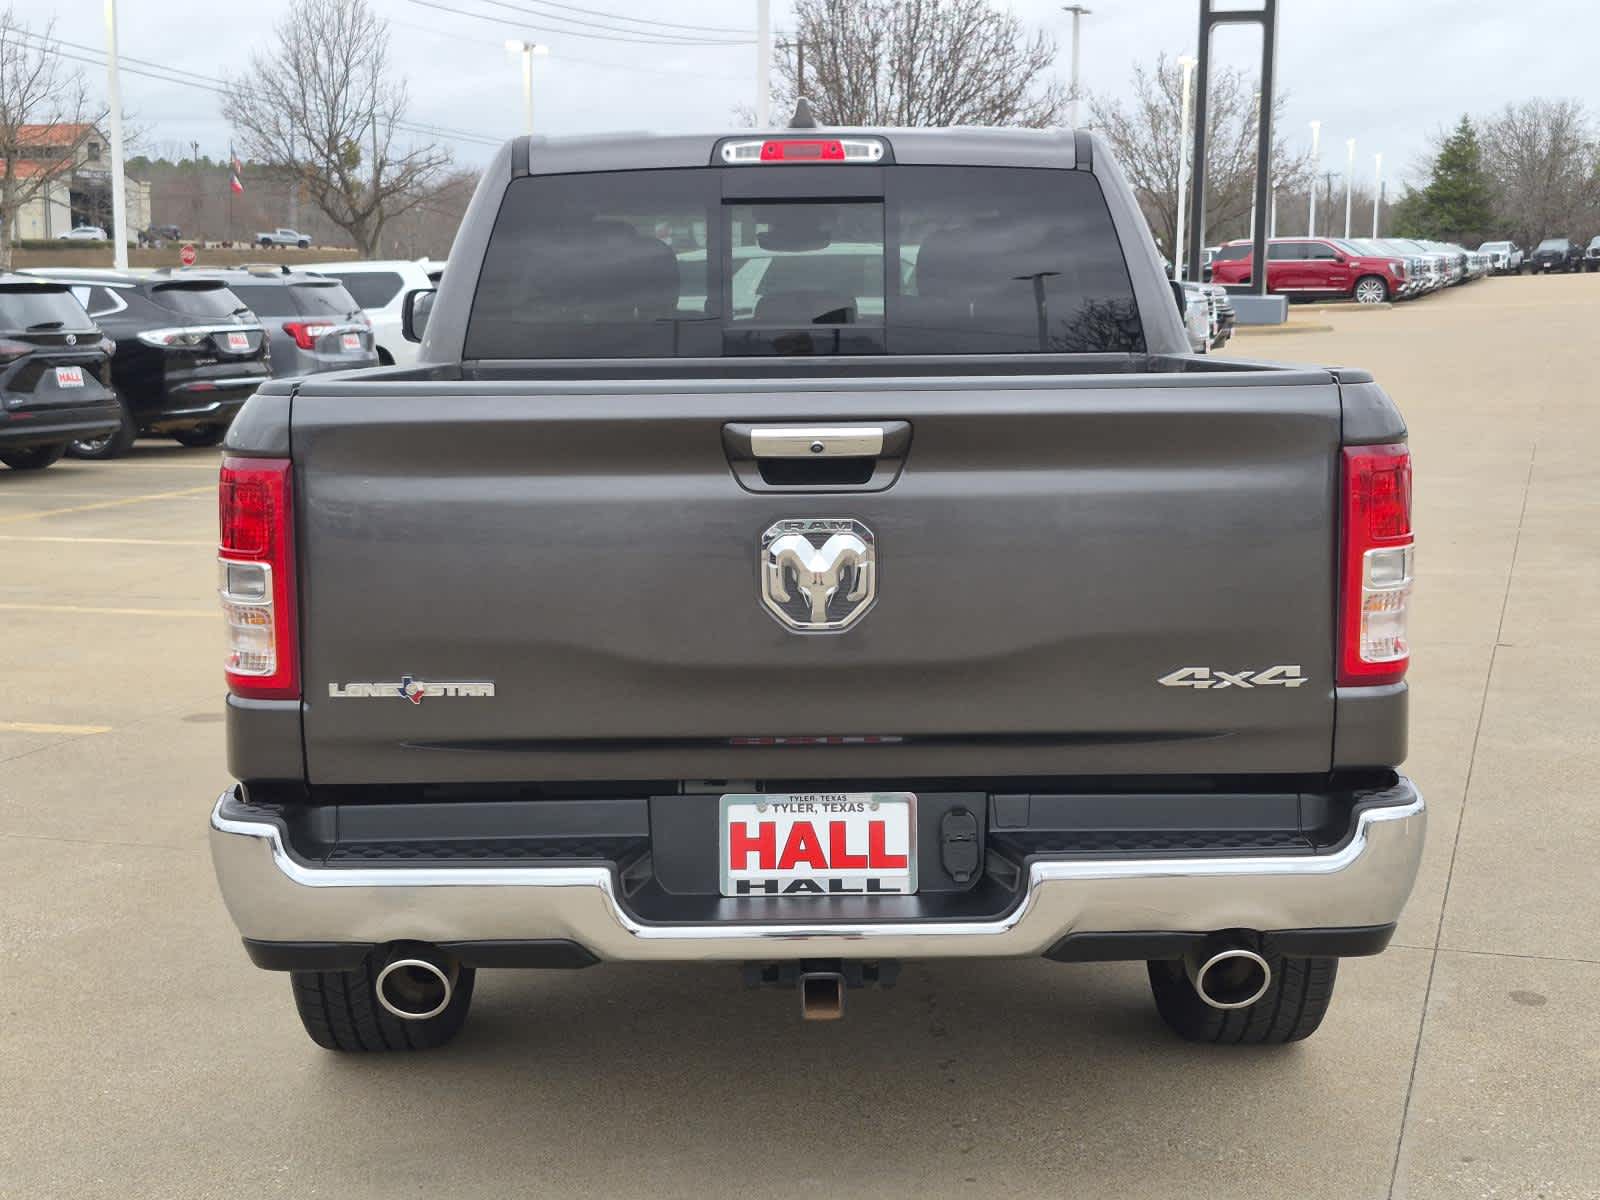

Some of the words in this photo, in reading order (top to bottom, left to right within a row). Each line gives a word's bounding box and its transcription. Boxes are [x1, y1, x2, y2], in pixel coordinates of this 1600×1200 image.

[59, 372, 81, 382] HALL
[784, 521, 853, 530] RAM
[328, 682, 401, 698] LONE
[424, 682, 496, 697] STAR
[772, 803, 819, 815] TYLER,
[822, 803, 865, 813] TEXAS
[729, 820, 908, 870] HALL
[736, 878, 901, 894] HALL
